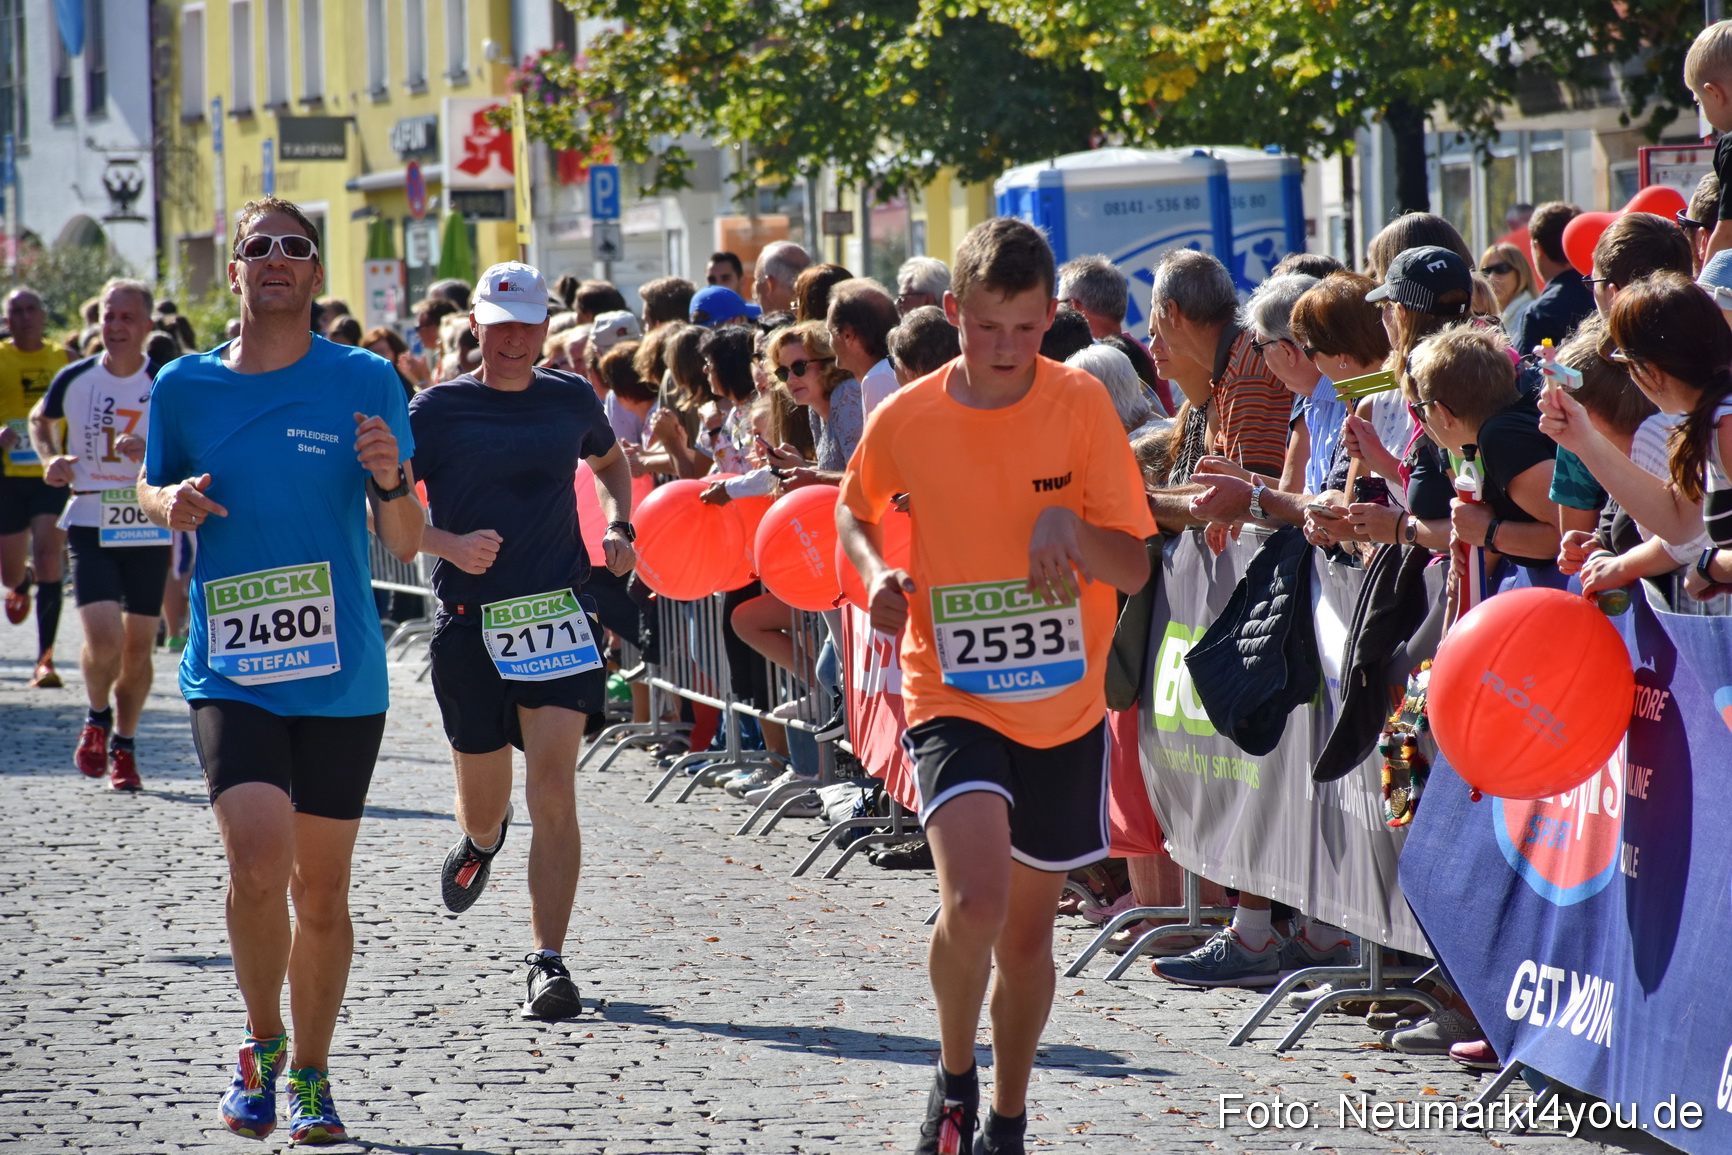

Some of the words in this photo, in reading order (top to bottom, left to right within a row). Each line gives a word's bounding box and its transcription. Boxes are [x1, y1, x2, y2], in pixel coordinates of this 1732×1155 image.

[282, 144, 344, 157] TAIFUN
[595, 172, 613, 215] P
[1103, 201, 1144, 216] 08141
[1155, 197, 1184, 213] 536
[1186, 195, 1200, 211] 80
[1230, 197, 1247, 210] 36
[1250, 194, 1266, 209] 80
[93, 407, 101, 437] LAUF
[296, 429, 339, 443] PFLEIDERER
[85, 426, 93, 461] STADT
[298, 443, 326, 455] Stefan
[107, 488, 138, 502] BO
[109, 507, 149, 525] 206
[114, 529, 159, 540] JOHANN
[214, 570, 320, 610] BOCK
[491, 594, 570, 626] BOCK
[223, 605, 322, 650] 2480
[496, 621, 577, 657] 2171
[952, 618, 1065, 665] 2533
[237, 650, 311, 673] STEFAN
[510, 653, 582, 674] MICHAEL
[987, 670, 1045, 690] LUCA
[1633, 685, 1670, 722] TORE
[1193, 744, 1208, 785] by
[1626, 762, 1653, 800] NLINE
[1506, 960, 1565, 1028] GET
